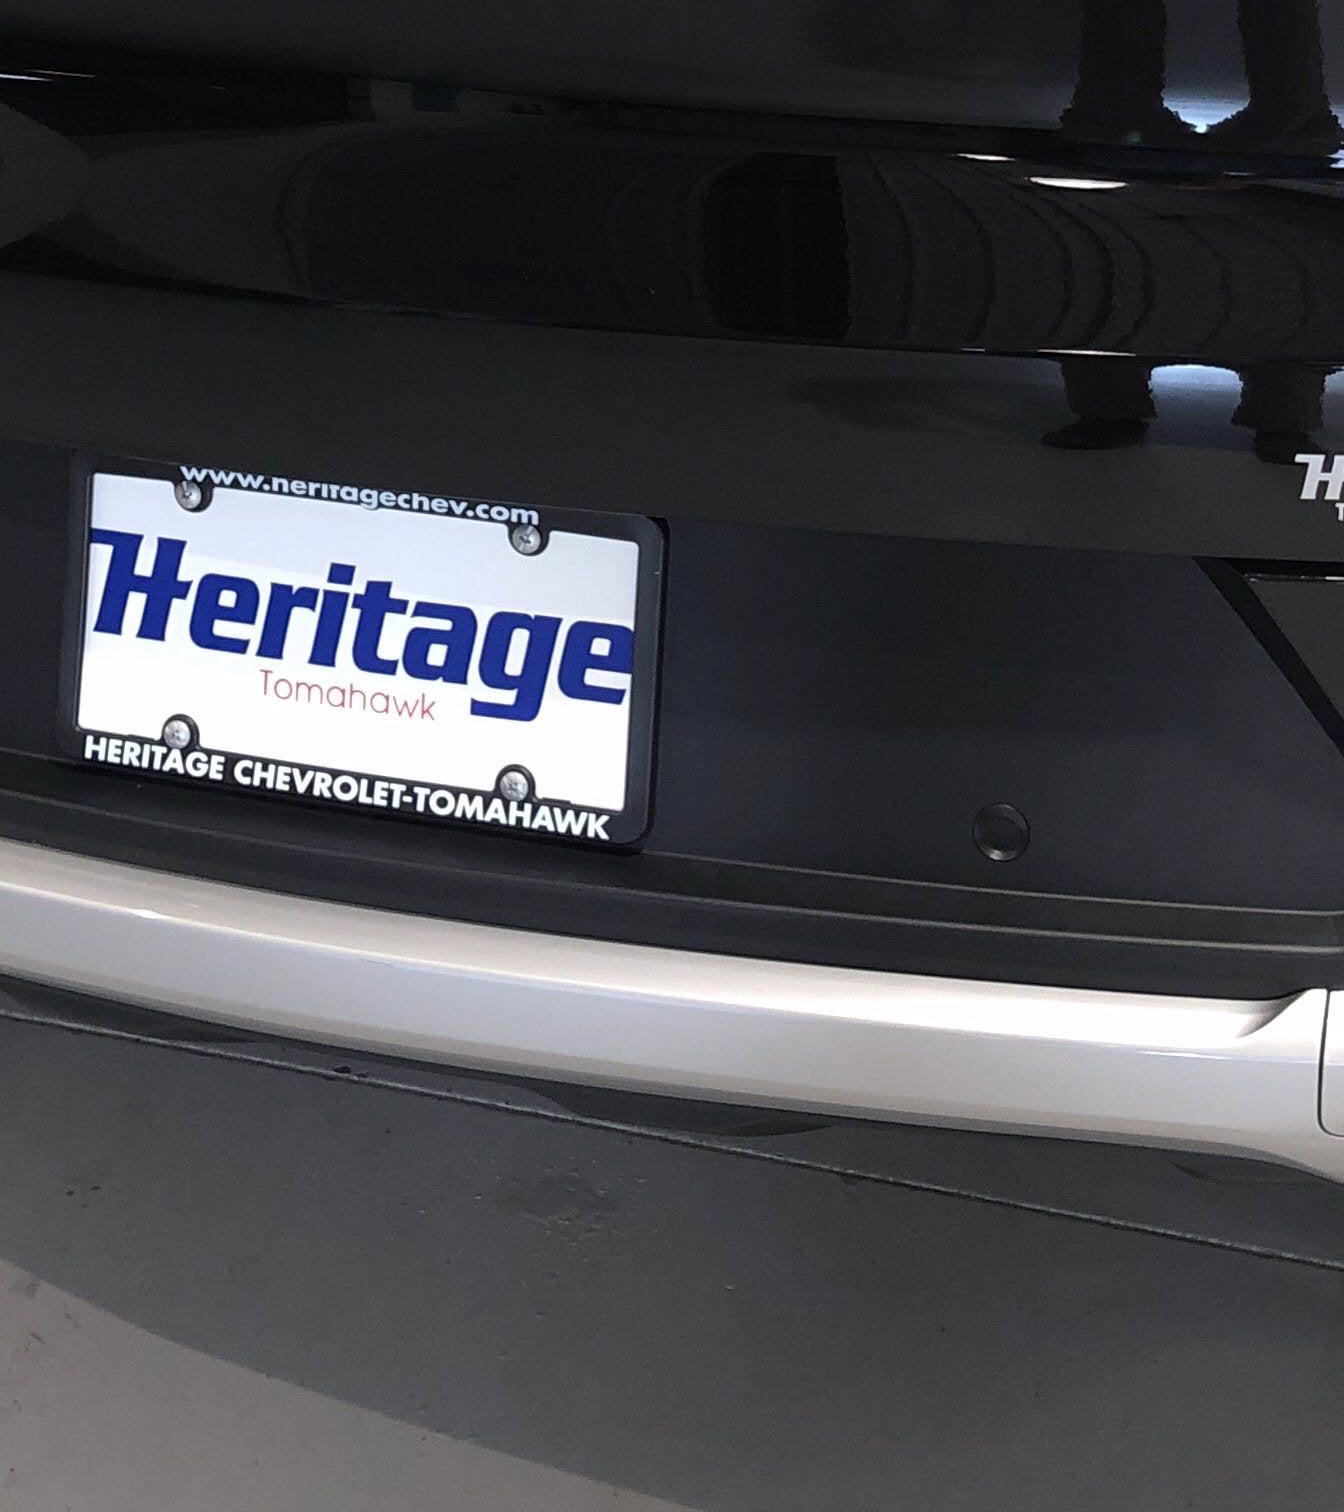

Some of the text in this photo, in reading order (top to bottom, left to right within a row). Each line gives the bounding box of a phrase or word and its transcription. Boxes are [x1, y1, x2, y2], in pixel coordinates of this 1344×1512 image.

[180, 465, 540, 525] www.heritagechev.com
[90, 527, 633, 722] Heritage
[259, 668, 437, 721] Tomahawk
[84, 734, 610, 841] HERITAGE CHEVROLET-TOMAHAWK
